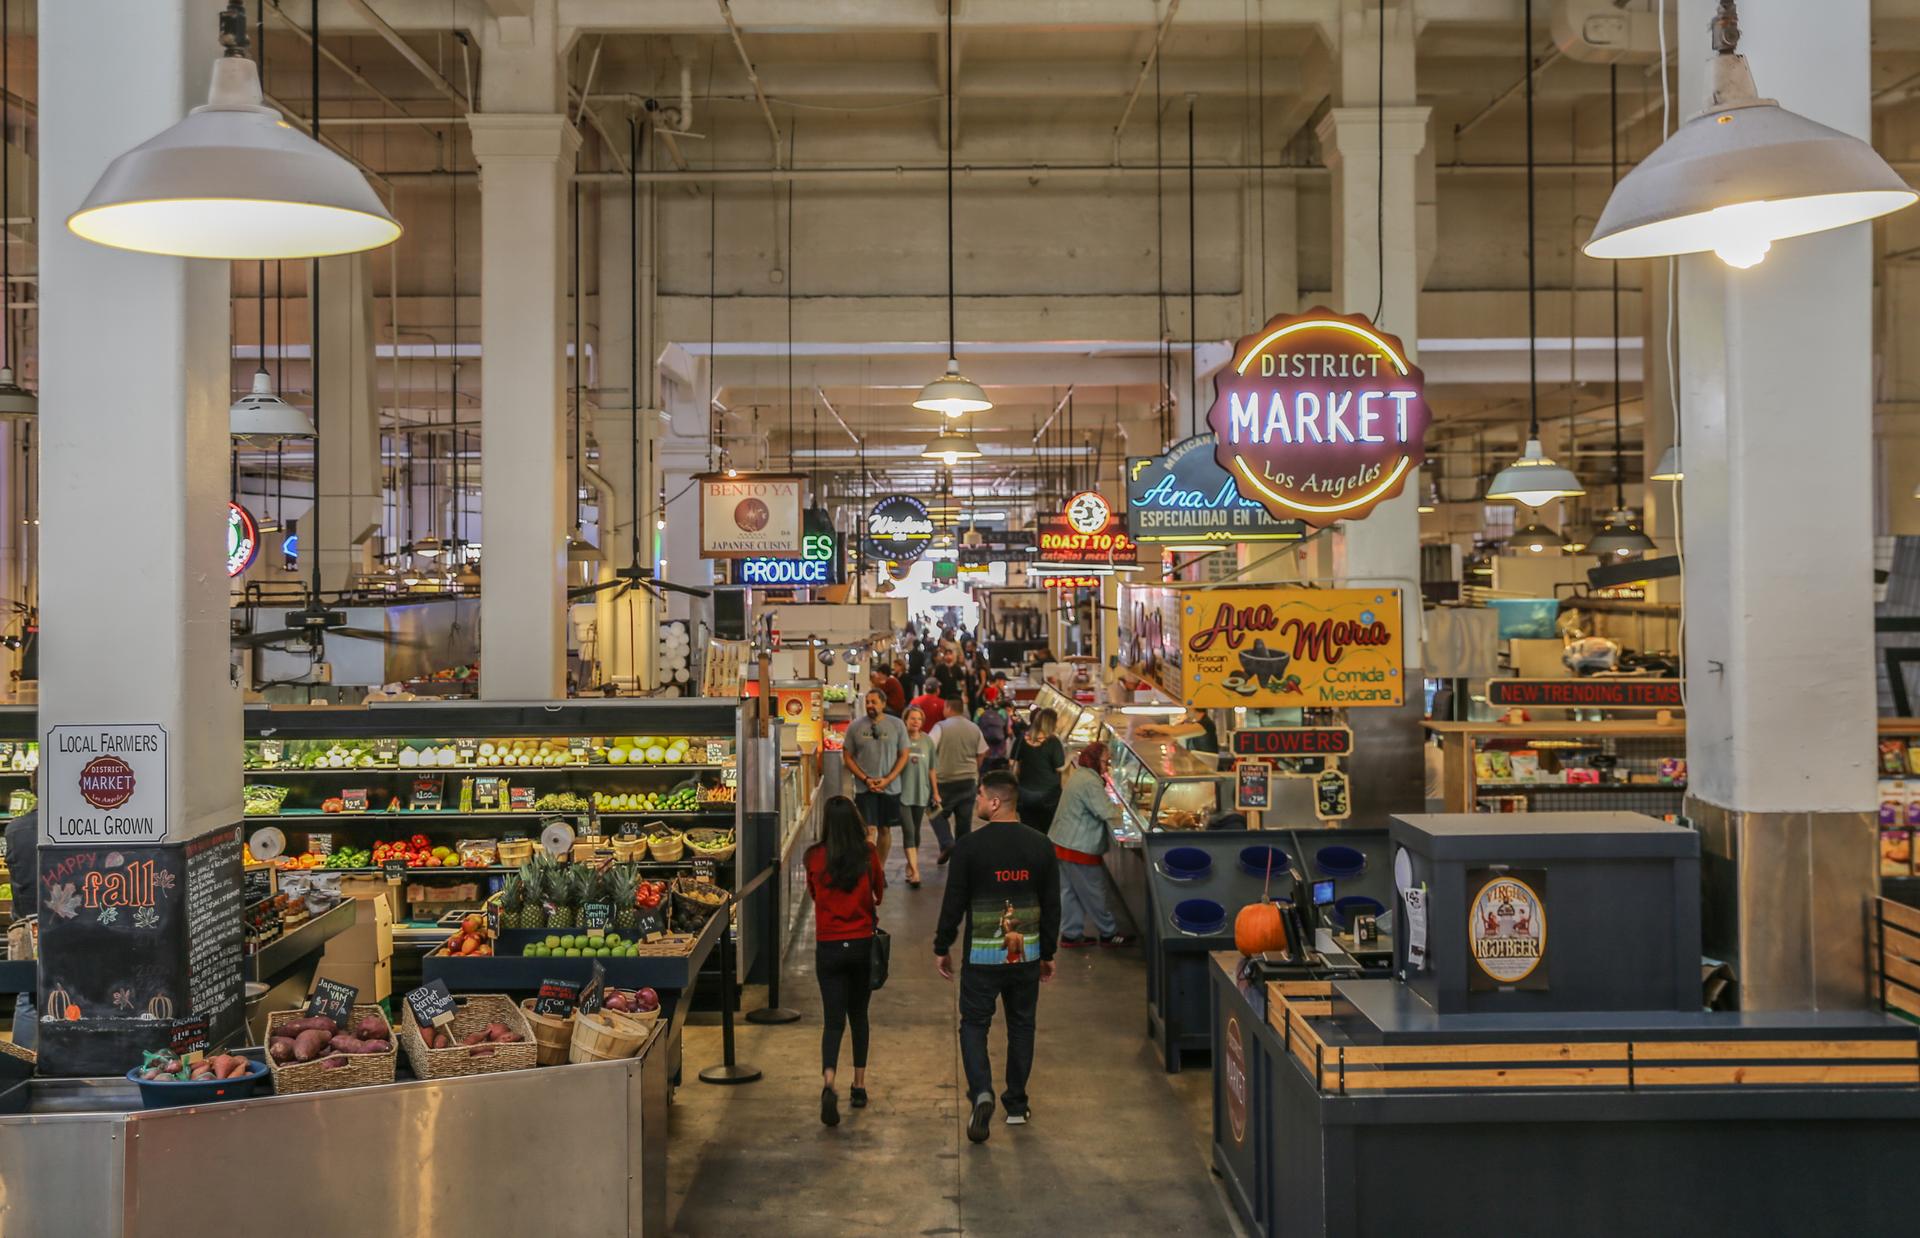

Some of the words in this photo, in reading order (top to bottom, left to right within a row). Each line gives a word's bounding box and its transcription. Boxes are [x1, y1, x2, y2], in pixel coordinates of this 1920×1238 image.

[1261, 353, 1382, 377] DISTRICT
[1230, 391, 1417, 443] MARKET
[1163, 436, 1211, 471] MEXICAN
[1264, 460, 1295, 489] Los
[1300, 463, 1381, 498] Angeles
[710, 484, 767, 497] BENTO
[772, 484, 793, 497] YA
[1132, 474, 1205, 508] Ana
[1140, 509, 1228, 528] ESPECIALIDAD
[1233, 509, 1250, 526] EN
[712, 541, 754, 551] JAPANESE
[757, 541, 793, 551] CUISINE
[1041, 534, 1090, 549] ROAST
[1091, 534, 1112, 550] TO
[743, 561, 827, 582] PRODUCE
[1189, 603, 1279, 653] Ana
[1280, 617, 1391, 665] Maria
[1189, 653, 1229, 663] Mexican
[1197, 663, 1223, 673] Food
[1323, 667, 1385, 684] Comida
[1319, 686, 1392, 702] Mexicana
[1501, 685, 1538, 702] NEW
[1543, 685, 1623, 702] TRENDING
[1627, 685, 1680, 702] ITEMS
[60, 733, 97, 752] LOCAL
[101, 733, 158, 752] FARMERS
[1240, 732, 1345, 752] FLOWERS
[91, 765, 123, 773] DISTRICT
[83, 776, 131, 790] MARKET
[60, 816, 100, 835] LOCAL
[104, 815, 153, 835] GROWN
[43, 853, 96, 888] HAPPY
[995, 870, 1029, 881] TOUR
[82, 860, 155, 908] fall
[583, 903, 610, 914] Granny
[585, 911, 608, 919] Smith
[318, 979, 355, 997] Japanese
[330, 991, 348, 1001] YAM
[409, 987, 429, 1003] RED
[414, 990, 439, 1011] Garnet
